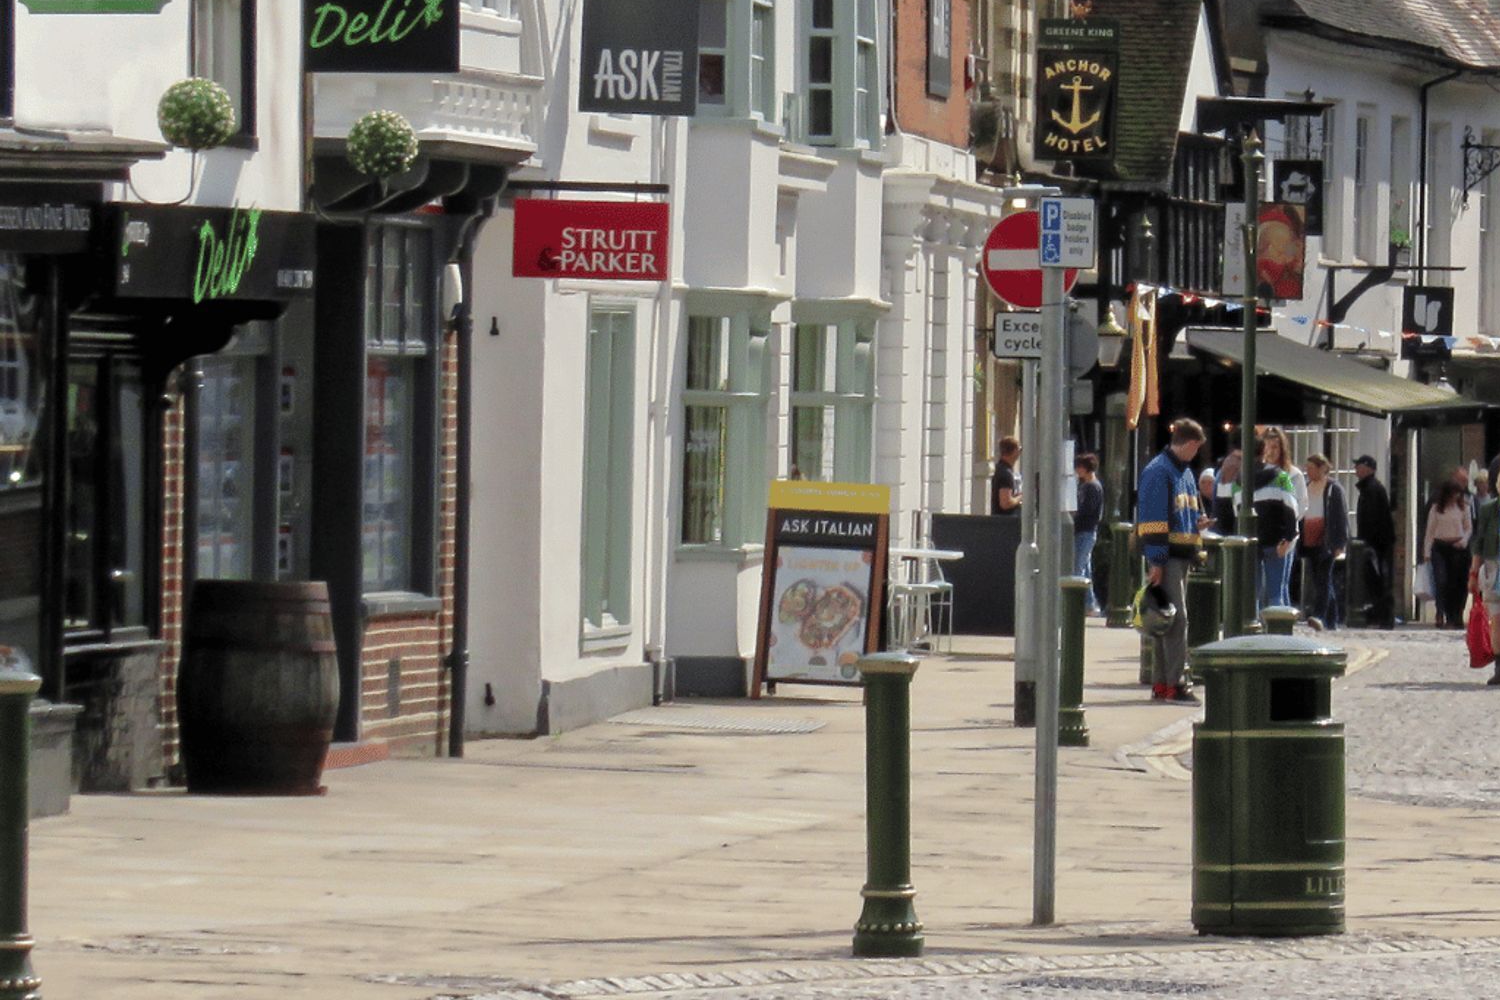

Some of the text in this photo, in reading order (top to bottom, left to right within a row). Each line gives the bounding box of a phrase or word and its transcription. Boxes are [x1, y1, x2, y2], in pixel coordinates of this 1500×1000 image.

[1046, 27, 1114, 38] GREENE KING
[593, 48, 661, 101] ASK
[1044, 59, 1112, 82] ANCHOR
[1044, 132, 1107, 153] HOTEL
[1045, 203, 1059, 228] P
[1063, 210, 1092, 221] Disabled
[562, 227, 657, 250] STRUTT
[1064, 233, 1090, 244] holders
[1067, 224, 1087, 236] badge
[556, 250, 658, 273] PARKER
[1002, 319, 1039, 332] Exce
[1004, 337, 1042, 351] cycle
[781, 519, 873, 537] ASK ITALIAN
